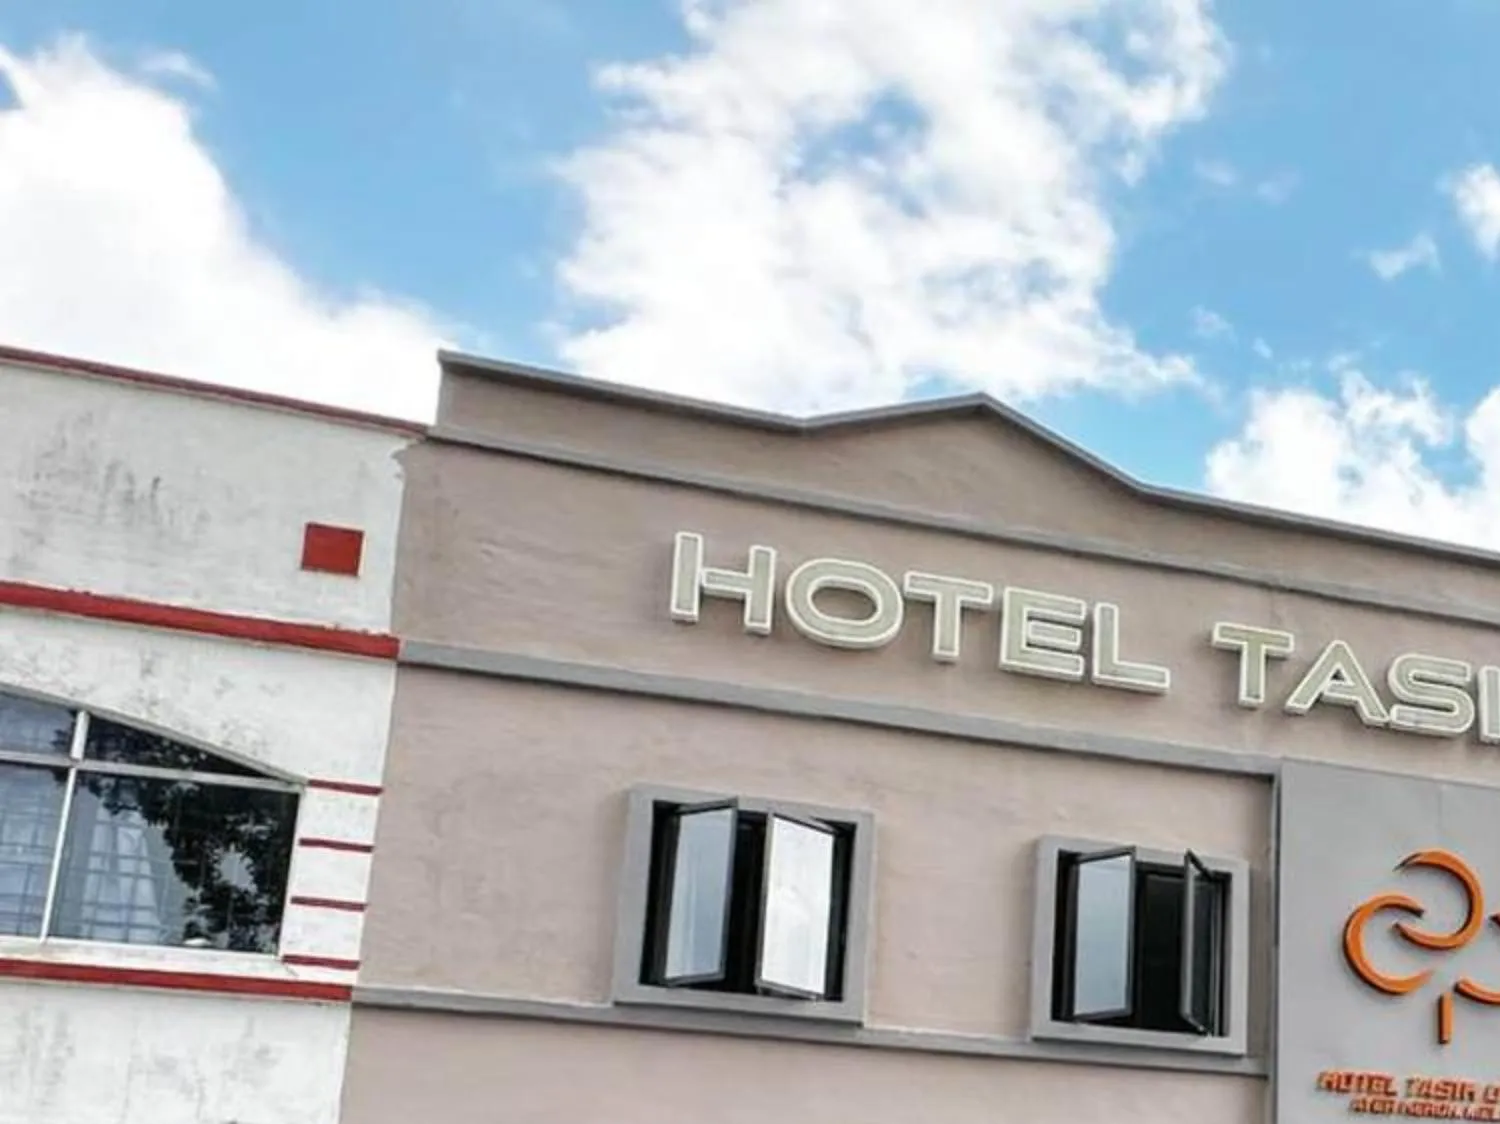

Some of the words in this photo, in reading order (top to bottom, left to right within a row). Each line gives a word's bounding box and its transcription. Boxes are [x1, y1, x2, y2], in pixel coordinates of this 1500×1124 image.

[670, 531, 1171, 694] HOTEL
[1315, 1070, 1398, 1097] HOTEL
[1404, 1075, 1476, 1102] TASIK
